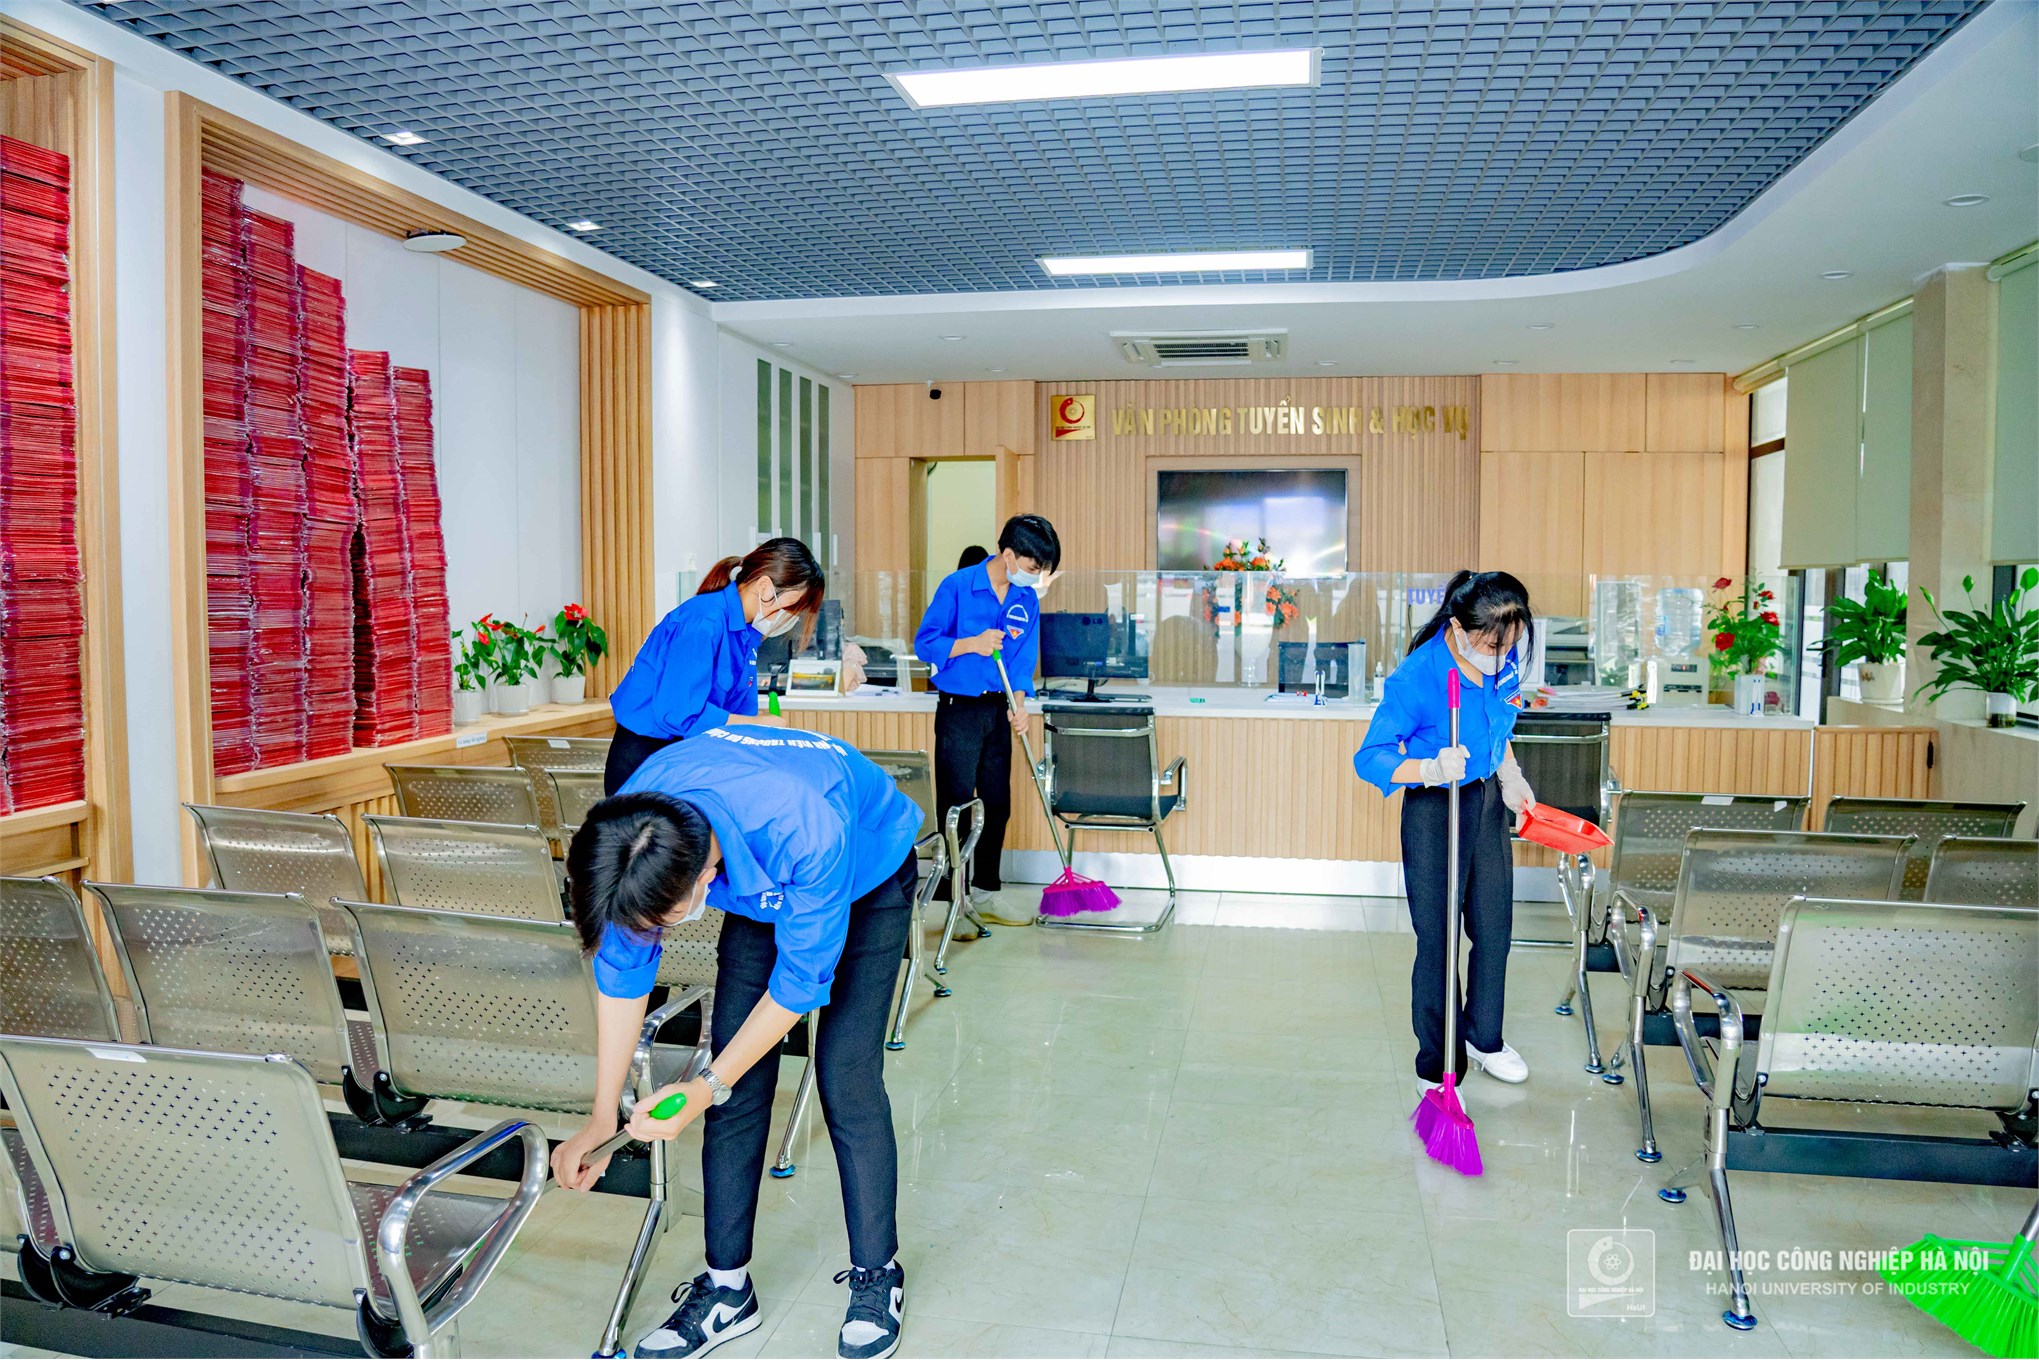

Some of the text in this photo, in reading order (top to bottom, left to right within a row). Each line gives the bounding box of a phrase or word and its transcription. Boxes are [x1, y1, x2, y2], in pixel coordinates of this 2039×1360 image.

[1111, 396, 1469, 441] VĂN PHÒNG TUYỂN SINH & HỌC VỤ
[1408, 581, 1445, 605] TUYỂ
